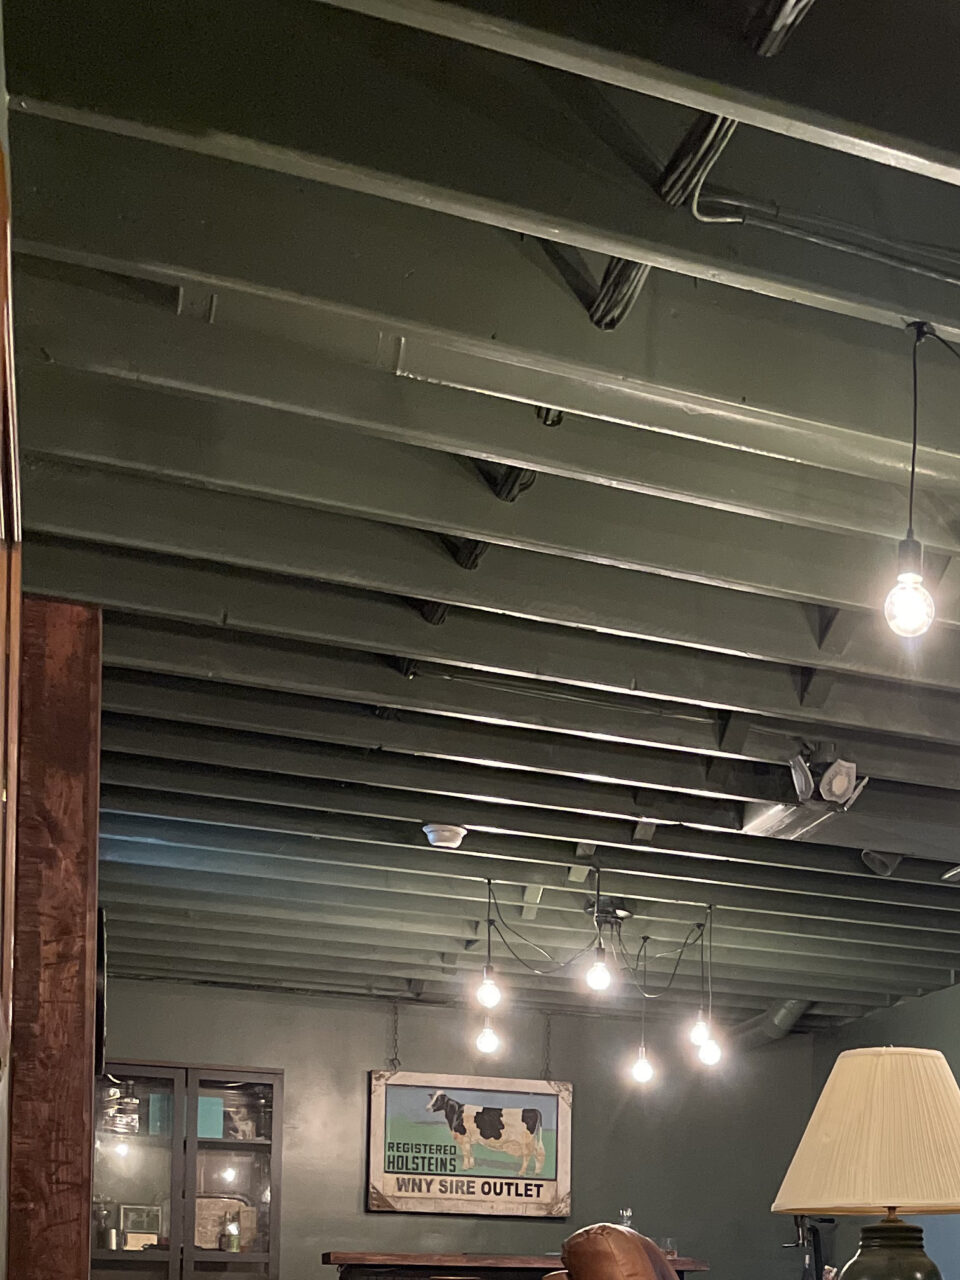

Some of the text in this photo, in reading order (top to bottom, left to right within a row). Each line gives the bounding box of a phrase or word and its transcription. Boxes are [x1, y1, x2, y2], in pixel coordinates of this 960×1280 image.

[387, 1142, 457, 1155] REGISTERED
[387, 1155, 457, 1173] HOLSTEINS
[396, 1177, 543, 1198] WNY SIRE OUTLET
